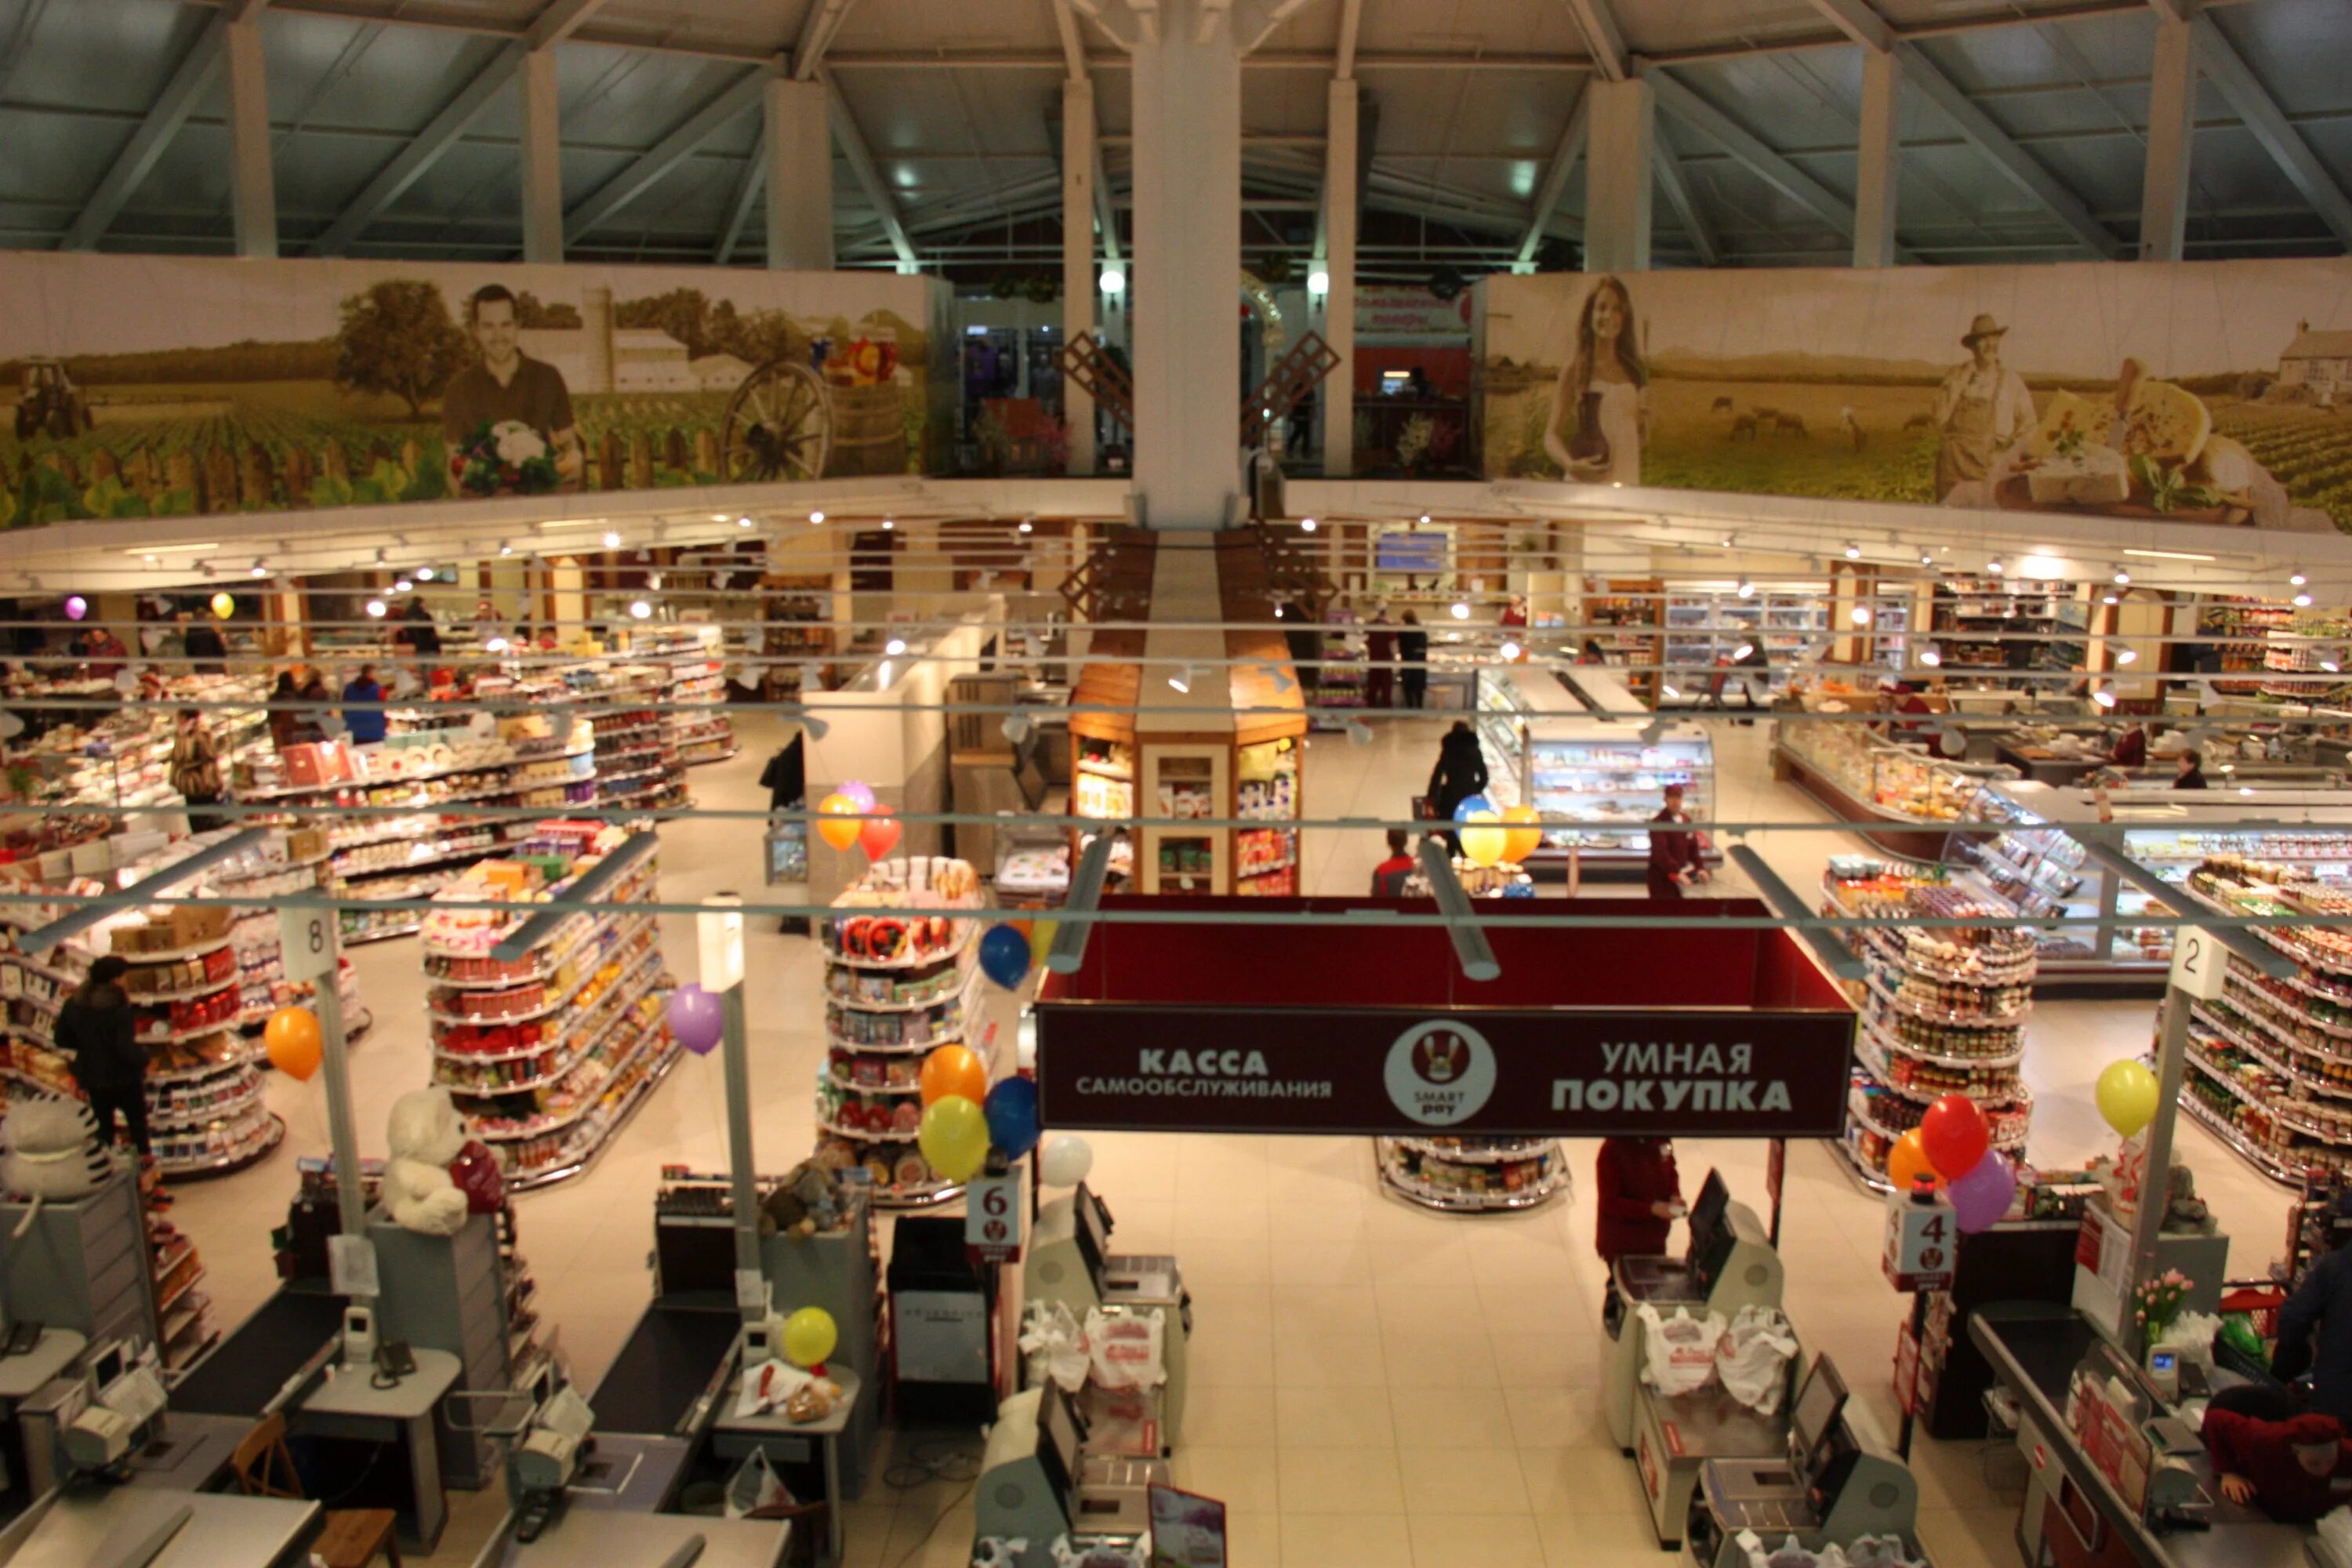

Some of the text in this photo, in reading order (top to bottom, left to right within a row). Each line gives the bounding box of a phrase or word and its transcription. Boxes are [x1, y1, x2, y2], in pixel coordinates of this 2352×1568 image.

[310, 919, 324, 953] 8
[2184, 938, 2199, 974] 2
[1139, 1049, 1269, 1076] КАССА
[1601, 1042, 1753, 1074] УМНАЯ
[1076, 1077, 1332, 1098] САМООБСЛУЖИВАНИЯ
[1414, 1091, 1465, 1103] SMART
[1552, 1079, 1793, 1112] ПОКУПКА
[982, 1185, 1008, 1216] 6
[1920, 1214, 1947, 1244] 4
